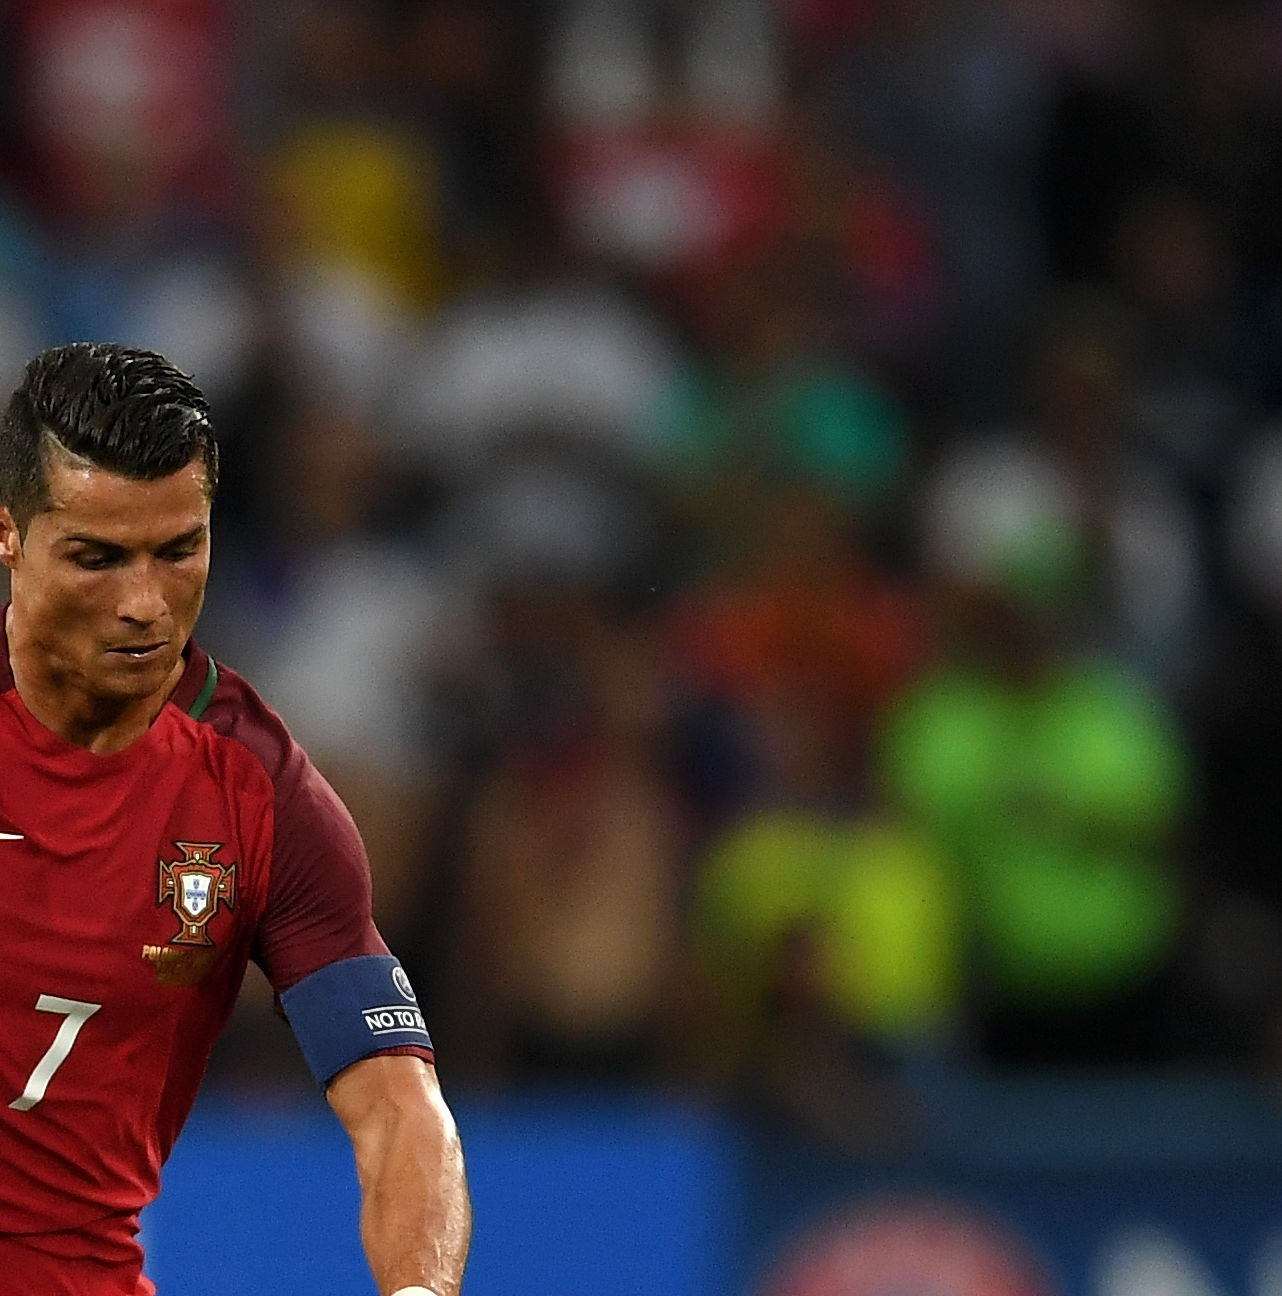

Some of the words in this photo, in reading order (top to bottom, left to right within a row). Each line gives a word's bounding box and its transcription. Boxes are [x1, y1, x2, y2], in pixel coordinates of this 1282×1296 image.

[8, 993, 102, 1111] 7
[365, 1012, 394, 1030] NO
[393, 1011, 415, 1027] TO
